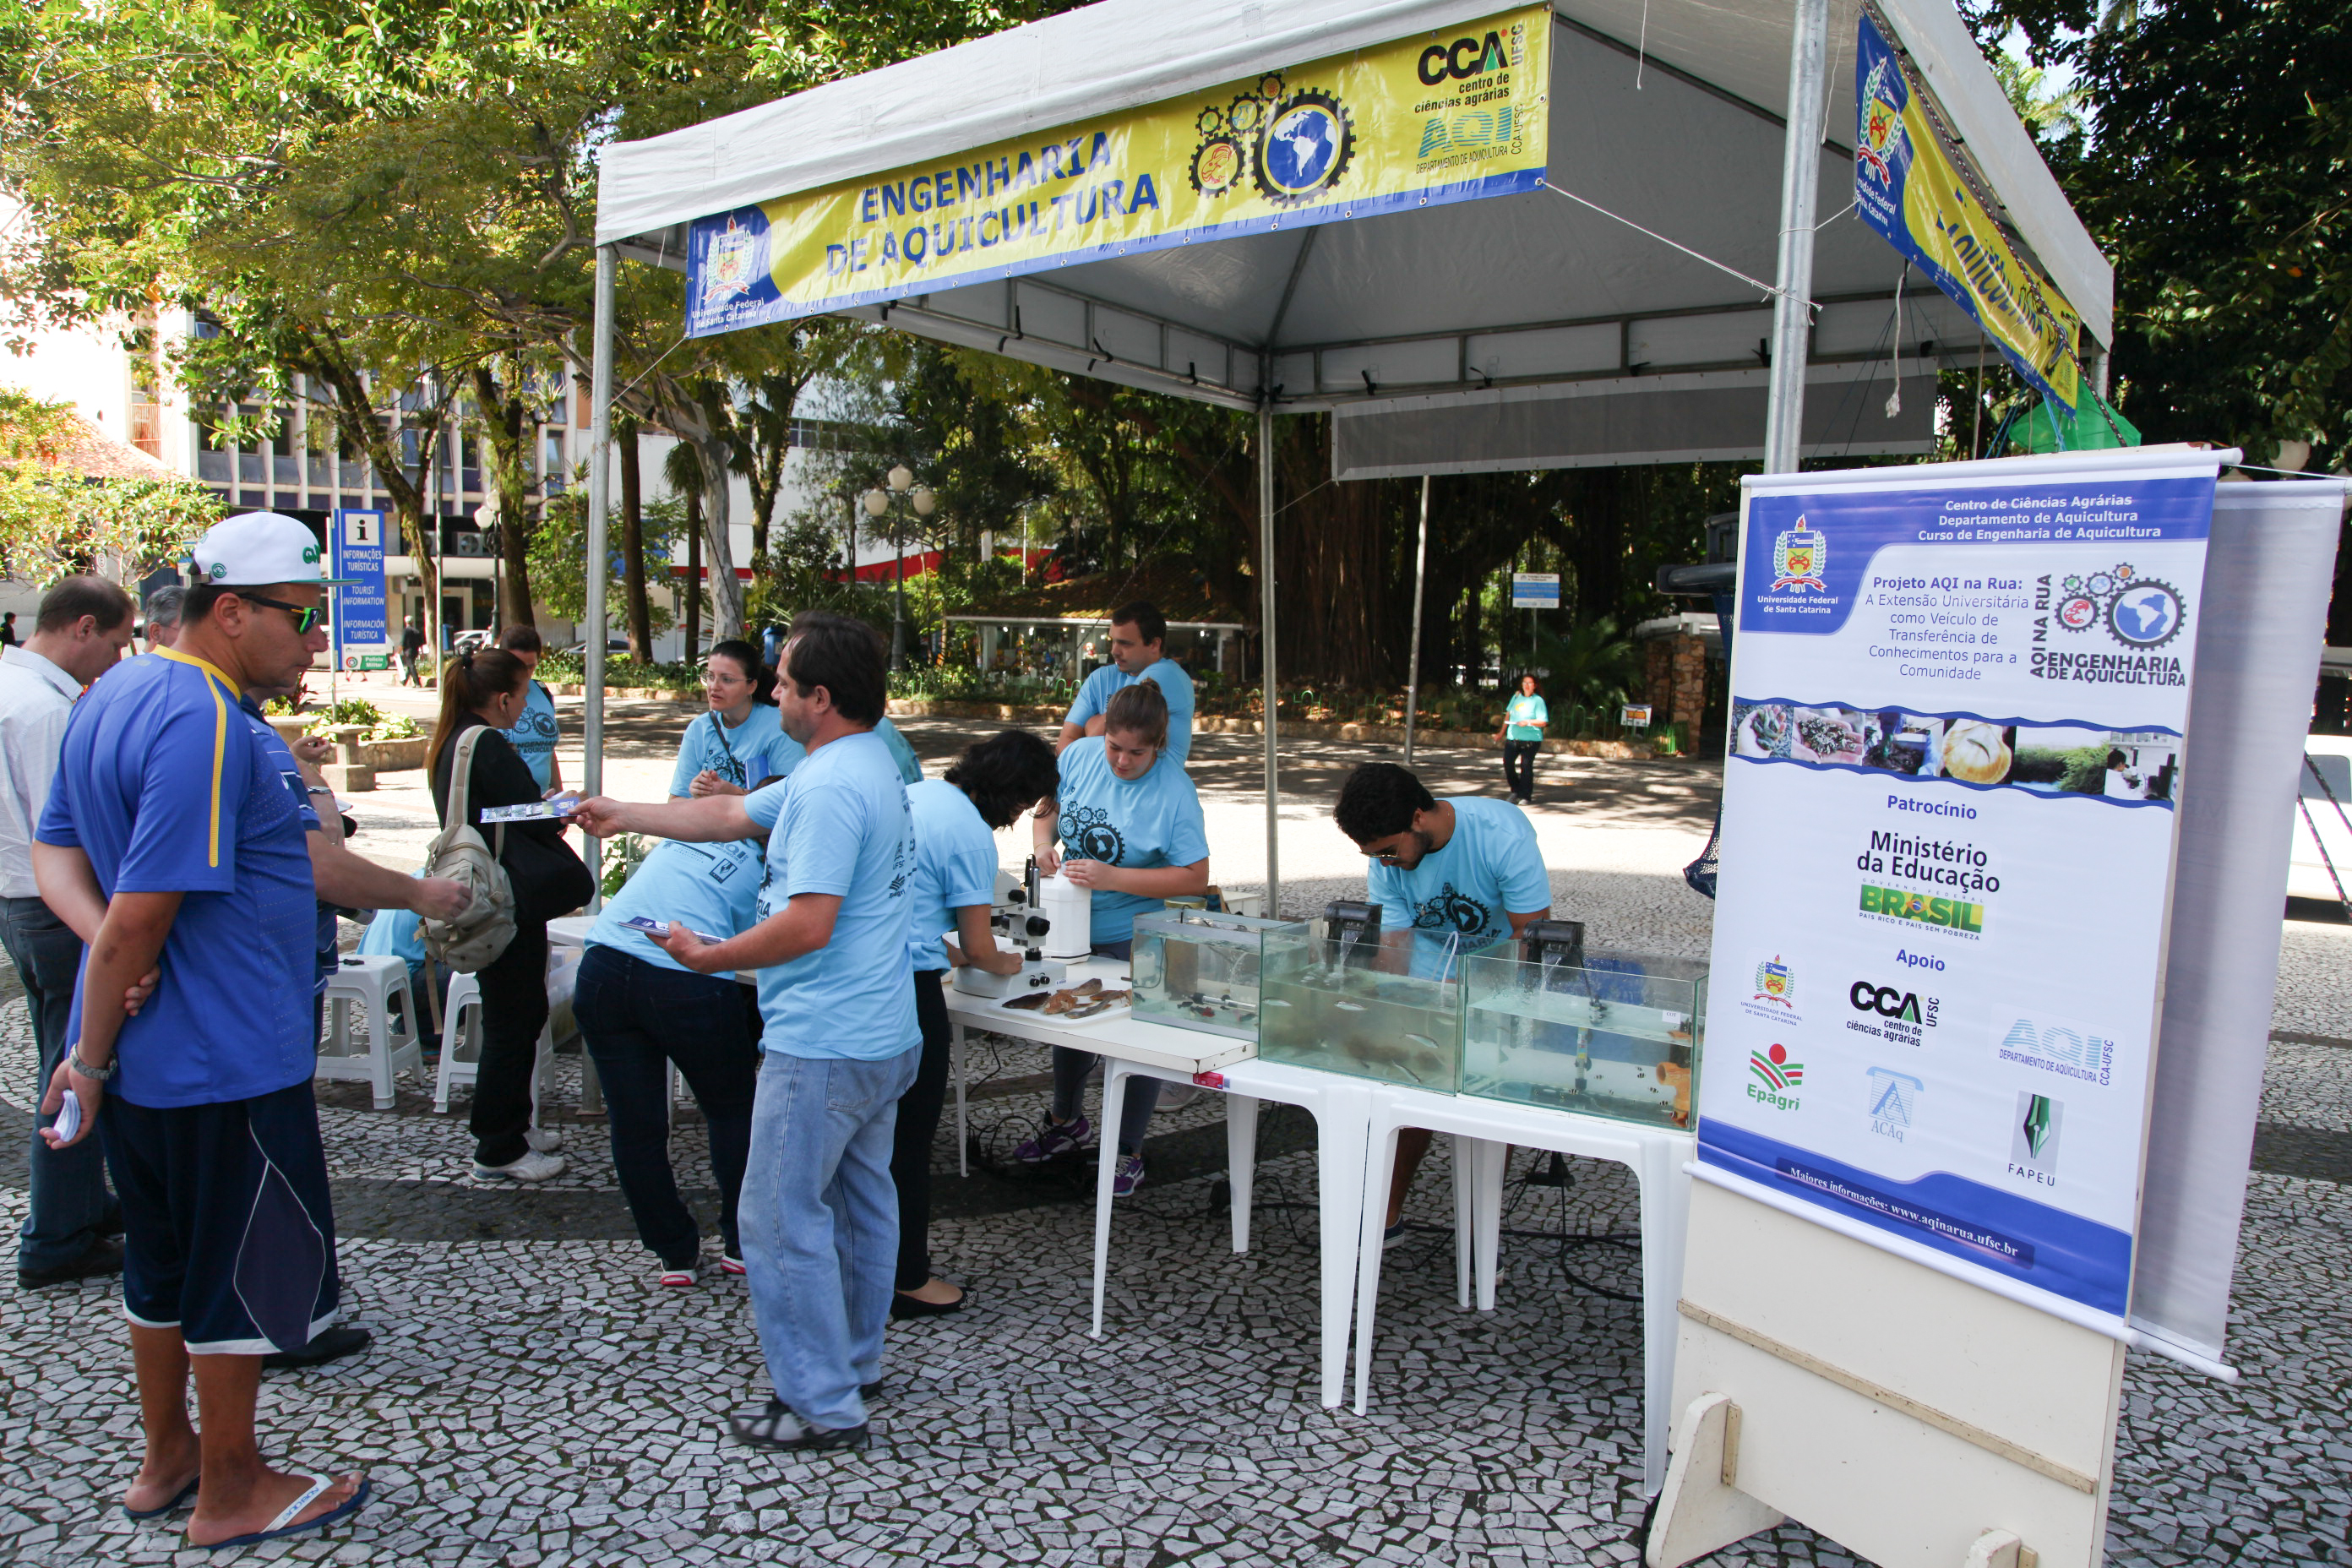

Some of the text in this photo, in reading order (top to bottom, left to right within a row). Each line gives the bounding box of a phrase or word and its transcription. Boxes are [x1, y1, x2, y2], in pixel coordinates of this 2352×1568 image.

[1511, 24, 1523, 66] UFSC
[1418, 30, 1509, 85] CCA
[1459, 73, 1510, 94] centro de
[1414, 87, 1510, 113] ciências agrárias
[1418, 106, 1512, 158] AQI
[1416, 155, 1459, 174] DEPARTAMENTO
[1461, 153, 1468, 165] DE
[862, 132, 1111, 223] ENGENHARIA
[1869, 202, 1888, 226] Catarina
[1875, 191, 1897, 215] Federal
[825, 173, 1160, 277] DE AQUICULTURA
[692, 297, 765, 318] Universidade Federal
[706, 316, 725, 326] Santa
[726, 310, 756, 321] Catarina
[1945, 493, 2132, 511] Centro de Ciências Agrárias
[1938, 510, 2138, 528] Departamento de Aquicultura
[1918, 525, 2162, 542] Curso de Engenharia de Aquicultura
[342, 547, 383, 562] INFORMAÇÕES
[347, 560, 379, 572] TURÍSTICAS
[351, 585, 375, 595] TOURIST
[1873, 576, 2023, 591] Projeto AQI na Rua:
[343, 596, 385, 606] INFORMATION
[1757, 595, 1838, 605] Universidade Federal
[1775, 605, 1797, 613] Santa
[1798, 606, 1832, 614] Catarina
[1865, 593, 2028, 608] A Extensão Universitária
[343, 618, 385, 629] INFORMACIÓN
[1890, 612, 1999, 626] como Veículo de
[2030, 574, 2052, 678] AQI NA RUA
[351, 629, 378, 640] TURÍSTICA
[1889, 629, 1998, 645] Transferência de
[1869, 645, 2017, 665] Conhecimentos para a
[2047, 651, 2181, 673] ENGENHARIA
[1899, 664, 1981, 680] Comunidade
[2047, 667, 2186, 687] DE AQUICULTURA
[1887, 795, 1978, 819] Patrocínio
[1870, 830, 1988, 868] Ministério
[1857, 850, 2001, 894] da Educação
[1862, 878, 1984, 903] GOVERNO FEDERAL
[1859, 884, 1984, 934] BRASIL
[1877, 916, 1896, 924] RICO
[1943, 928, 1980, 941] POBREZA
[1896, 949, 1946, 972] Apoio
[1740, 1001, 1803, 1021] UNIVERSIDADE FEDERAL
[1849, 980, 1923, 1025] CCA
[1925, 997, 1940, 1027] UFSC
[1753, 1010, 1770, 1019] SANTA
[1771, 1015, 1797, 1026] CATARINA
[1884, 1019, 1923, 1037] centro de
[1846, 1020, 1920, 1048] ciências agrárias
[2001, 1019, 2103, 1070] AQI
[1999, 1048, 2045, 1070] DEPARTAMENTO
[2045, 1060, 2055, 1072] DE
[2099, 1039, 2114, 1086] CCA-UFSC
[1746, 1082, 1800, 1111] Epagri
[1870, 1119, 1903, 1142] ACAq
[2008, 1162, 2055, 1187] FAPEU
[1790, 1167, 2018, 1256] Maiores informações: www.aqinarua.ufsc.br
